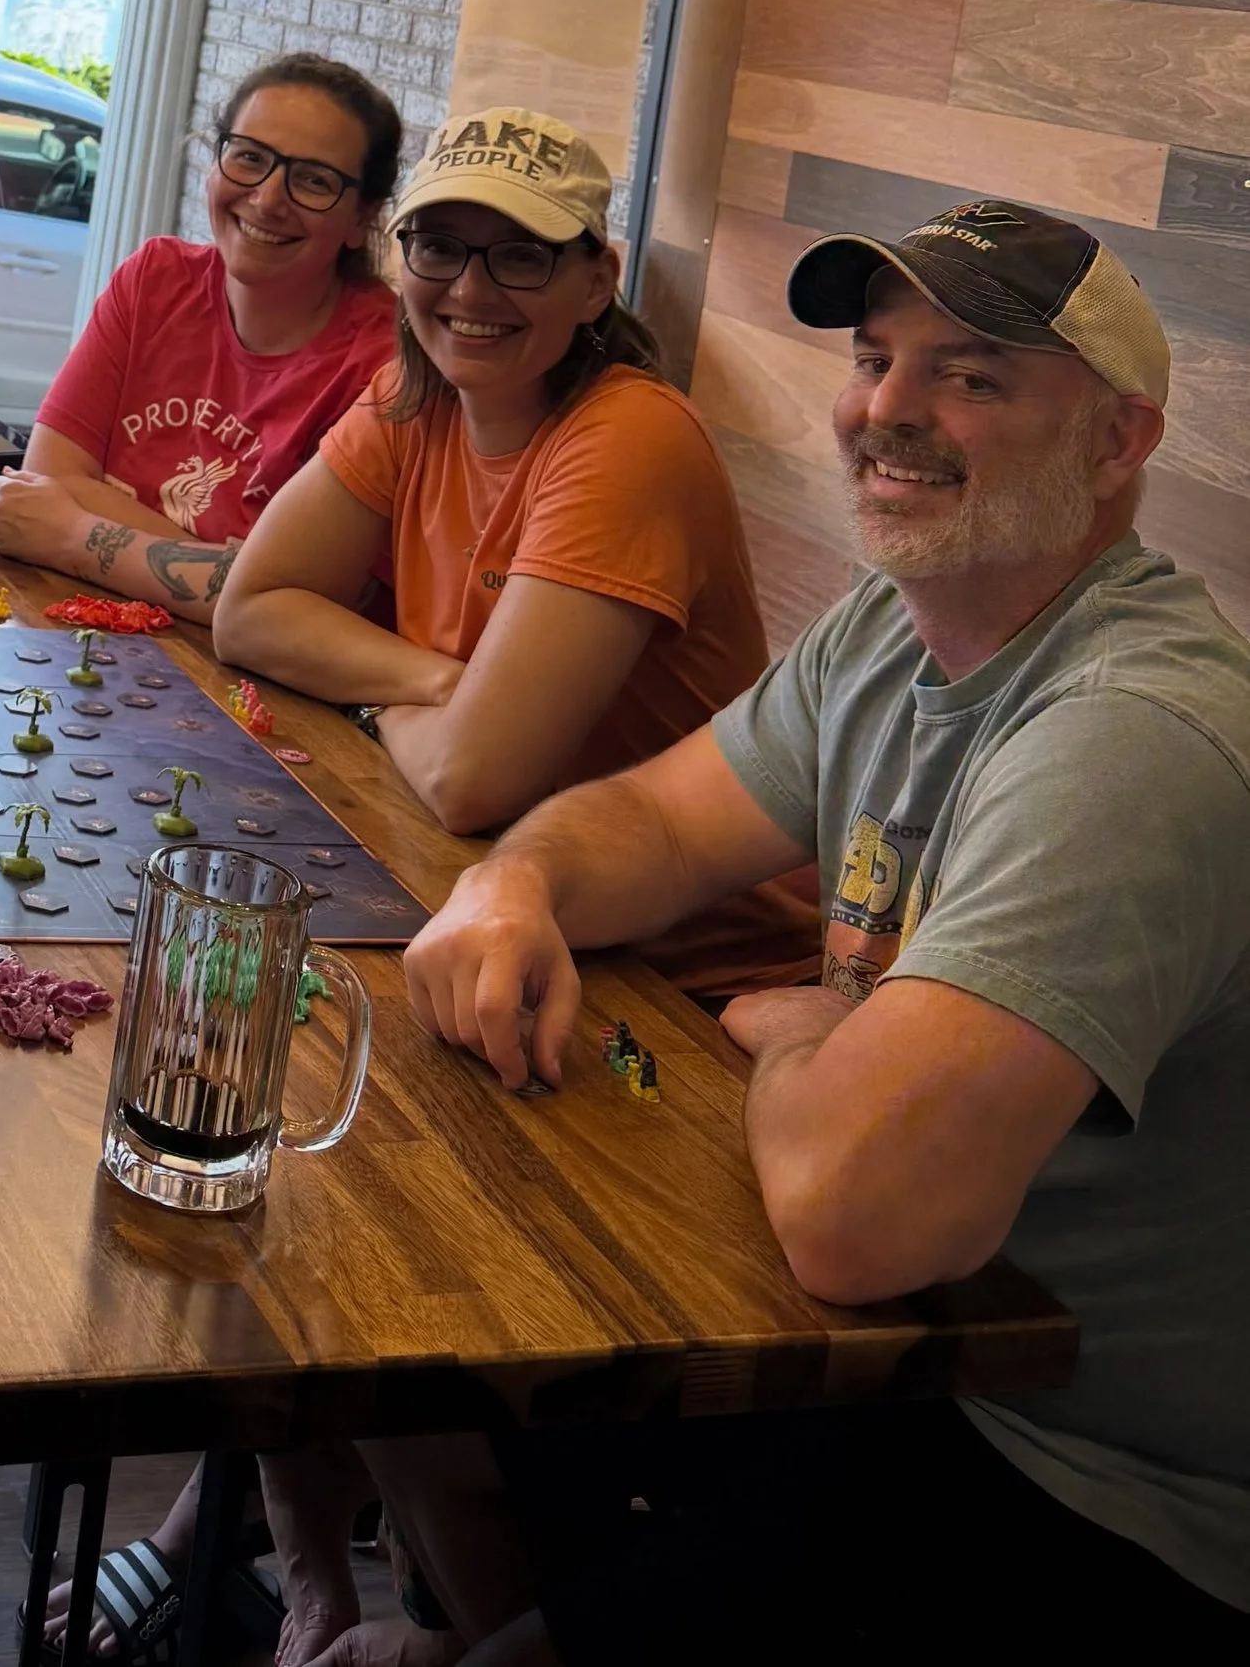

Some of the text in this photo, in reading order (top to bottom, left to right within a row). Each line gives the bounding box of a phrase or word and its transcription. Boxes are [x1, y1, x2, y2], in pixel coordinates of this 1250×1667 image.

[429, 120, 569, 176] LAKE
[434, 149, 544, 182] PEOPLE
[951, 228, 993, 252] STAR
[139, 1594, 181, 1641] adidas
